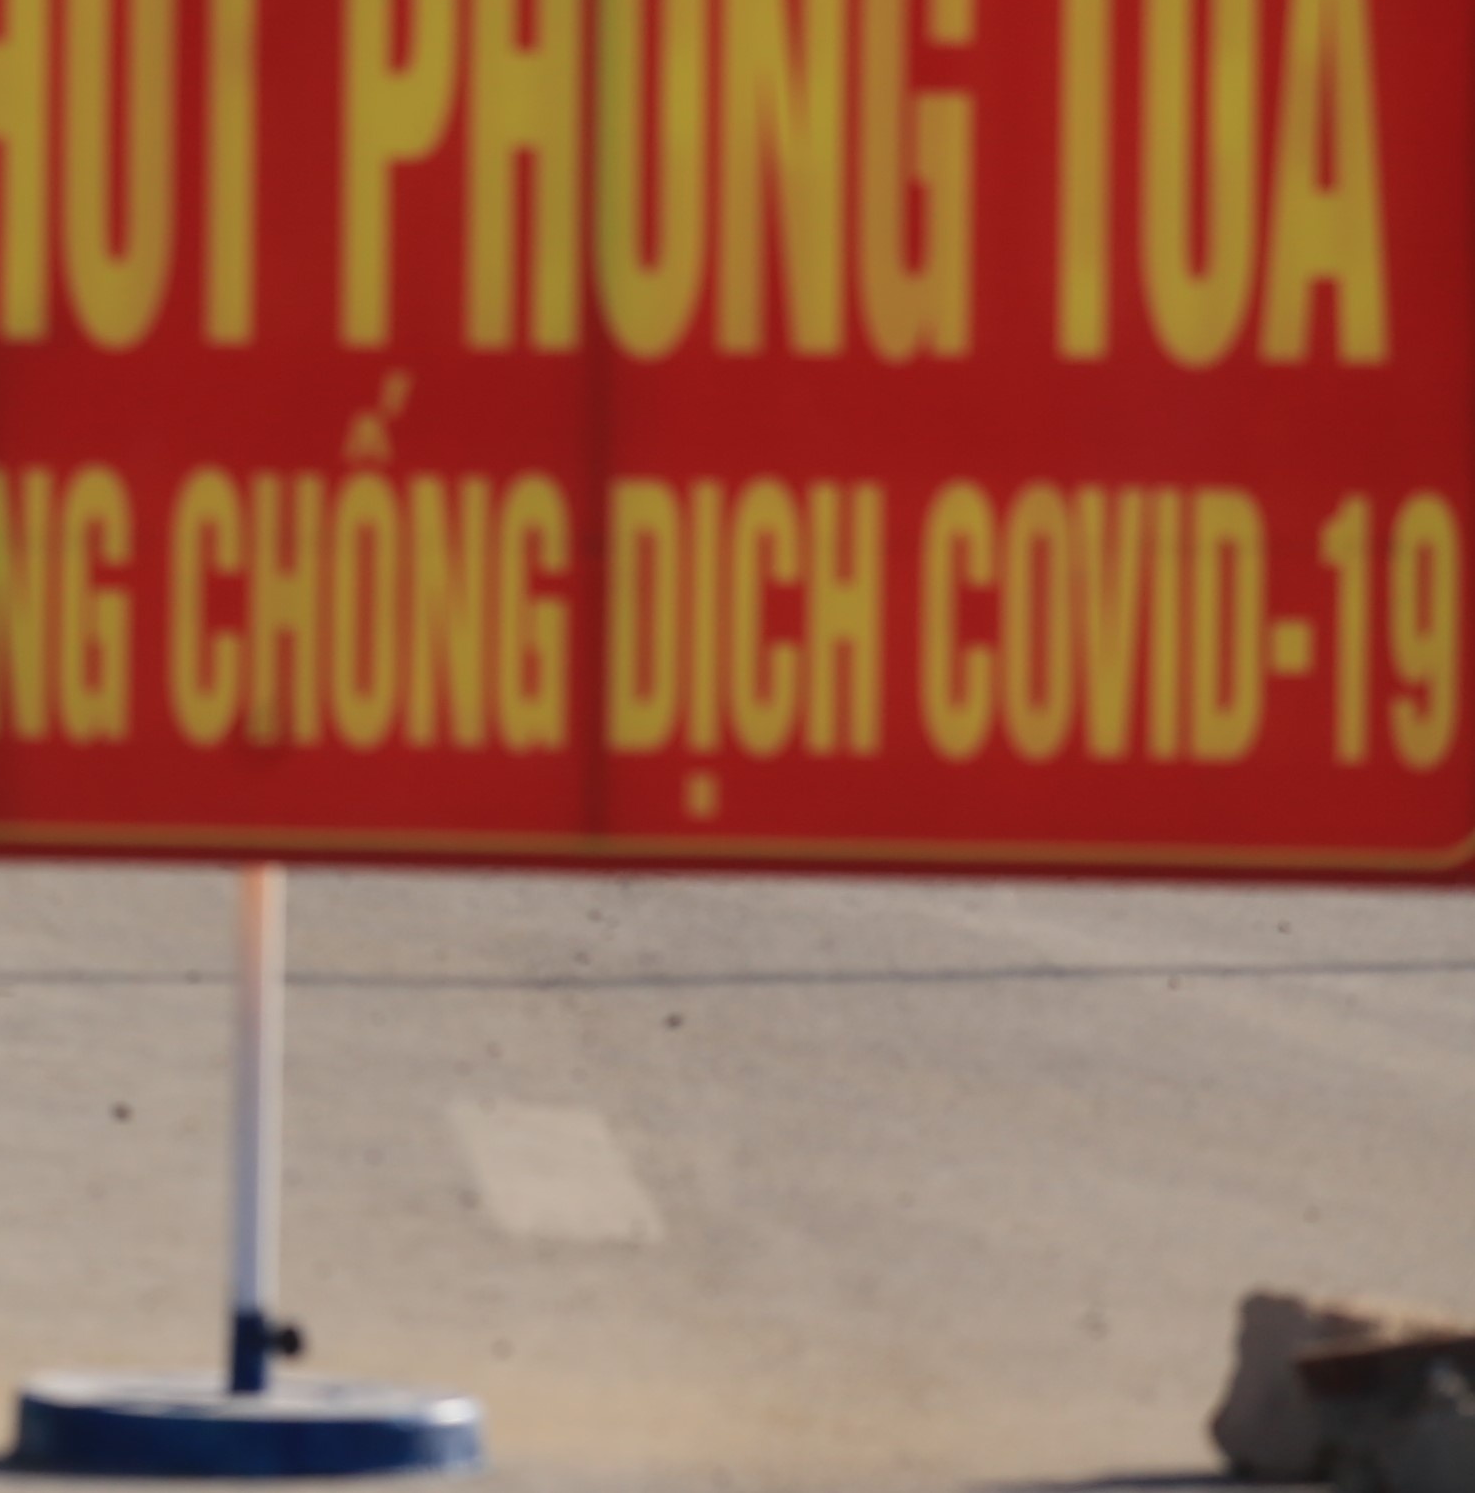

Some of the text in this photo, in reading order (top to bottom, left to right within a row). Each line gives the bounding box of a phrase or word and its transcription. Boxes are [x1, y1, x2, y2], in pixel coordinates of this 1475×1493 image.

[169, 373, 569, 750] CHỐNG
[607, 478, 883, 819] DỊCH
[920, 481, 1460, 770] COVID-19
